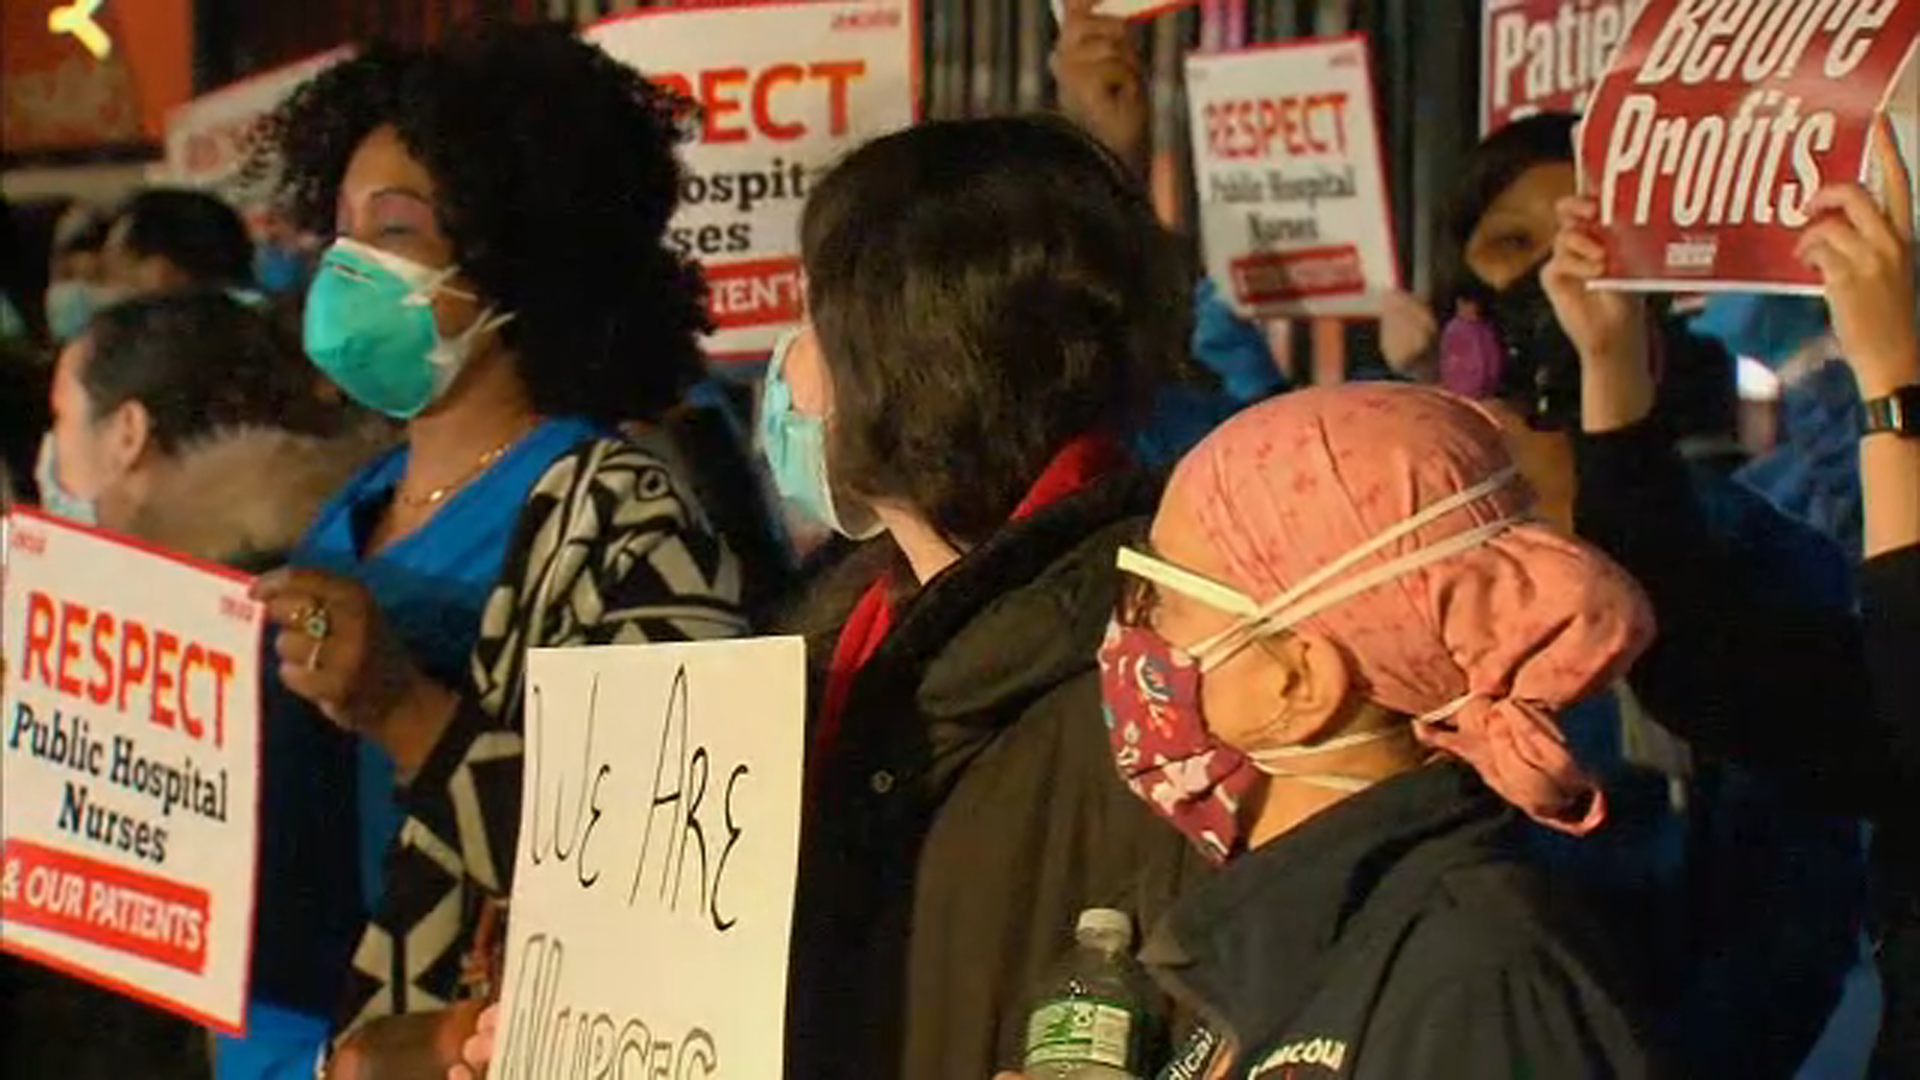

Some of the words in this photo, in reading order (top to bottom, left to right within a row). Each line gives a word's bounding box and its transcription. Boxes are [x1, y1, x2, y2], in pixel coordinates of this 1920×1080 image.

[1634, 0, 1899, 84] Before
[1205, 92, 1348, 159] RESPECT
[1601, 89, 1837, 229] Profits
[1267, 164, 1358, 211] Hospital
[671, 223, 751, 254] ses
[22, 591, 235, 750] RESPECT
[9, 702, 104, 776] Public
[110, 734, 228, 823] Hospital
[629, 663, 750, 931] ARE
[58, 780, 168, 864] Nurses
[2, 859, 20, 900] &
[25, 865, 85, 917] OUR
[87, 880, 204, 953] PATIENTS
